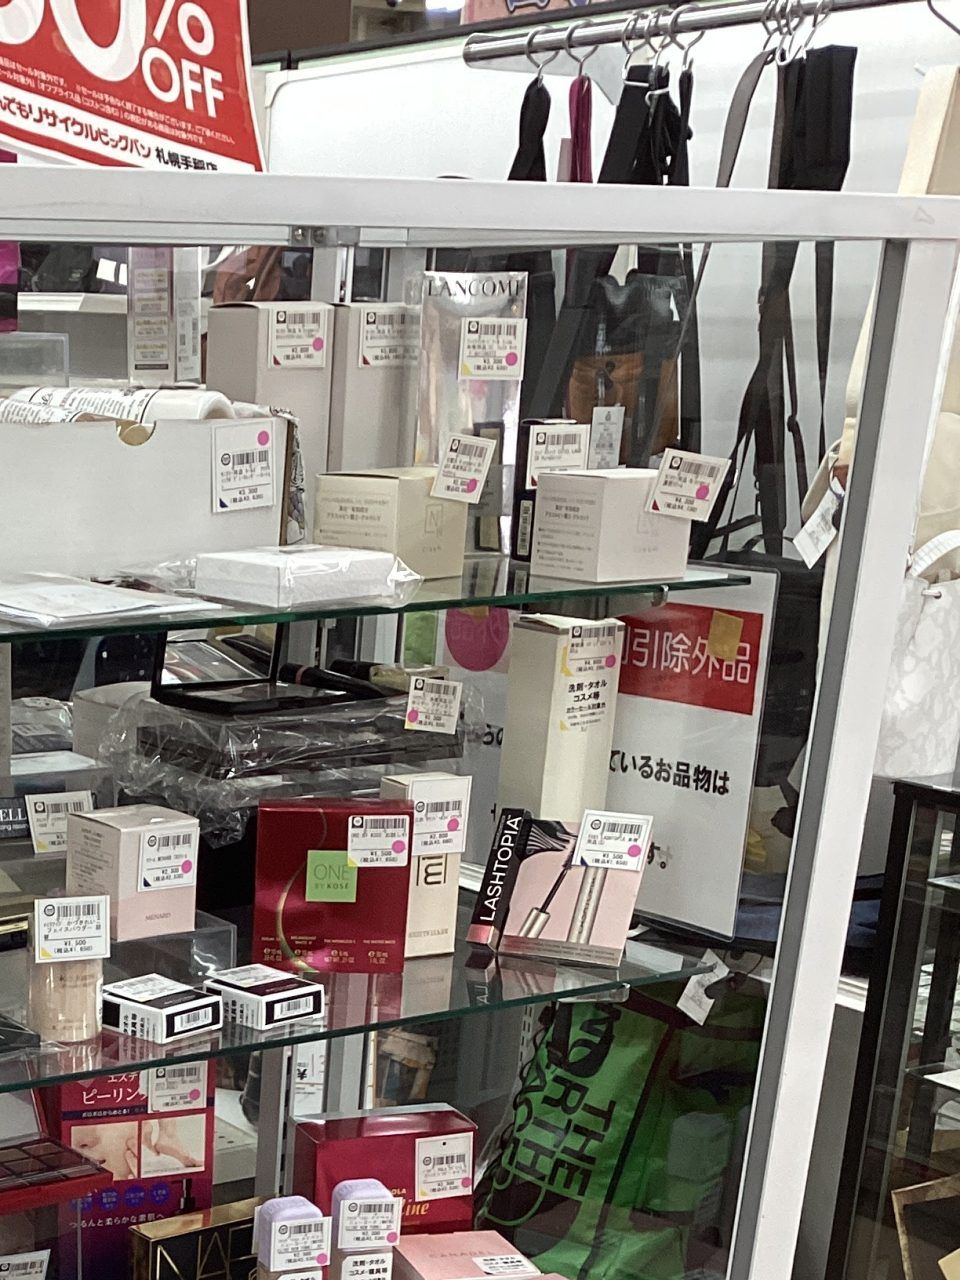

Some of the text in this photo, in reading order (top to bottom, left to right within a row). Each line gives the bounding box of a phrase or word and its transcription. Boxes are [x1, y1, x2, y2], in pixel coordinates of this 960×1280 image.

[142, 47, 224, 118] OFF
[313, 863, 349, 881] ONE
[480, 815, 523, 923] LASHTOPIA
[82, 1088, 147, 1105] ピーリン
[548, 1100, 618, 1198] THE
[391, 1188, 407, 1196] OLA
